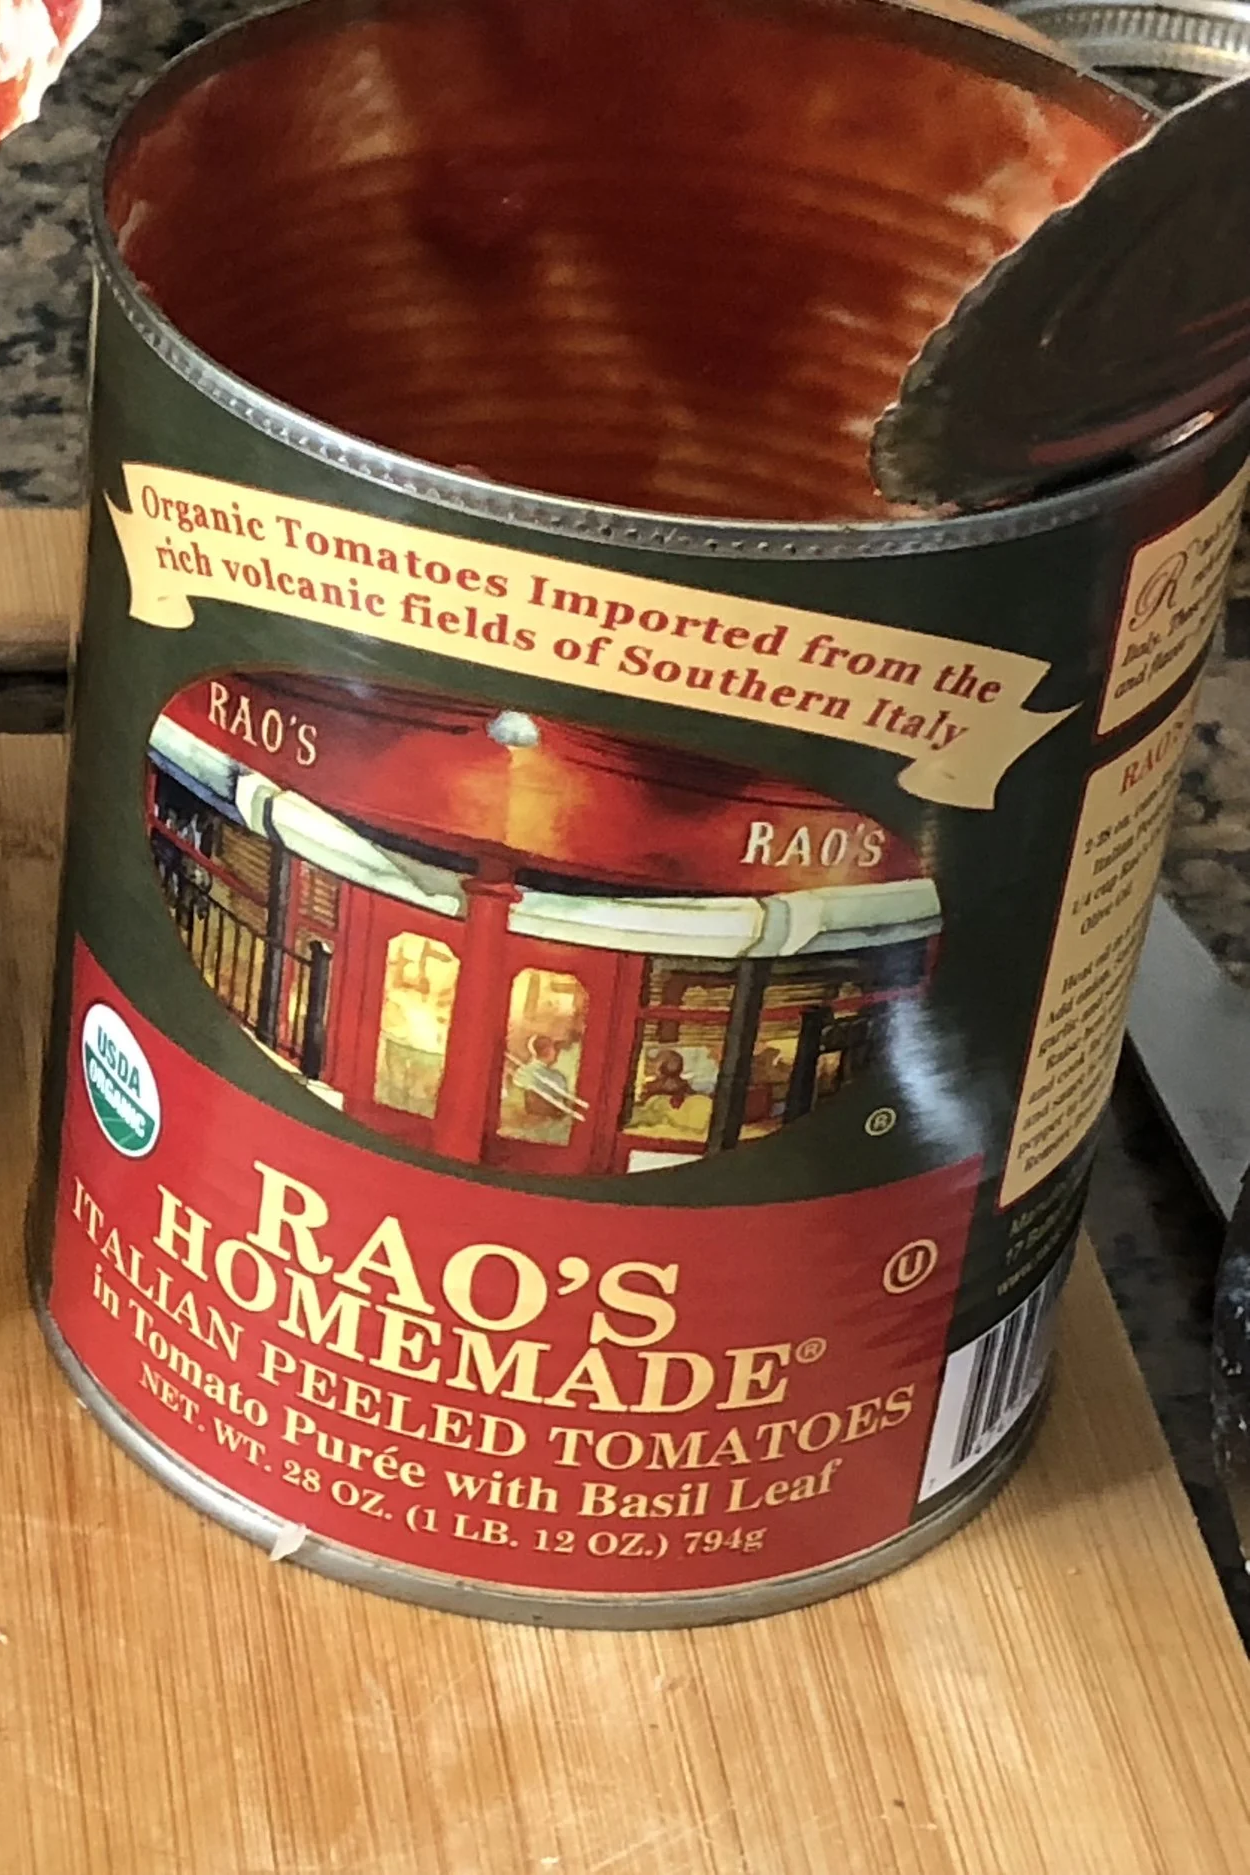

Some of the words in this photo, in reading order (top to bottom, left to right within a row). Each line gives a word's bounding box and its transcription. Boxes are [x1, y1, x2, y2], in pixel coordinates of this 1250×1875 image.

[140, 483, 267, 543] Organic
[274, 513, 510, 599] Tomatoes
[527, 574, 790, 656] Imported
[797, 632, 922, 689] from
[931, 662, 1004, 705] the
[155, 535, 213, 578] rich
[221, 556, 387, 618] volcanic
[399, 592, 538, 653] fields
[552, 626, 614, 667] of
[617, 645, 854, 722] Southern
[861, 696, 971, 753] Italy
[206, 680, 319, 769] RAO'S
[739, 819, 887, 869] RAO'S
[96, 1023, 142, 1099] USDA
[70, 1175, 246, 1363] ITALIAN
[258, 1338, 527, 1458] PEELED
[548, 1383, 917, 1472] TOMATOES
[246, 1160, 680, 1348] RAO'S
[91, 1264, 120, 1319] in
[128, 1296, 269, 1429] Tomato
[280, 1405, 427, 1489] Purée
[444, 1469, 559, 1515] with
[577, 1480, 708, 1521] Basil
[723, 1457, 844, 1516] Leaf
[138, 1363, 207, 1434] NET.
[213, 1417, 274, 1474] WT.
[282, 1457, 322, 1495] 28
[331, 1480, 394, 1521] OZ.
[405, 1505, 440, 1533] (1
[452, 1508, 519, 1549] LB.
[533, 1528, 577, 1556] 12
[588, 1530, 669, 1559] OZ.)
[684, 1526, 768, 1555] 794g
